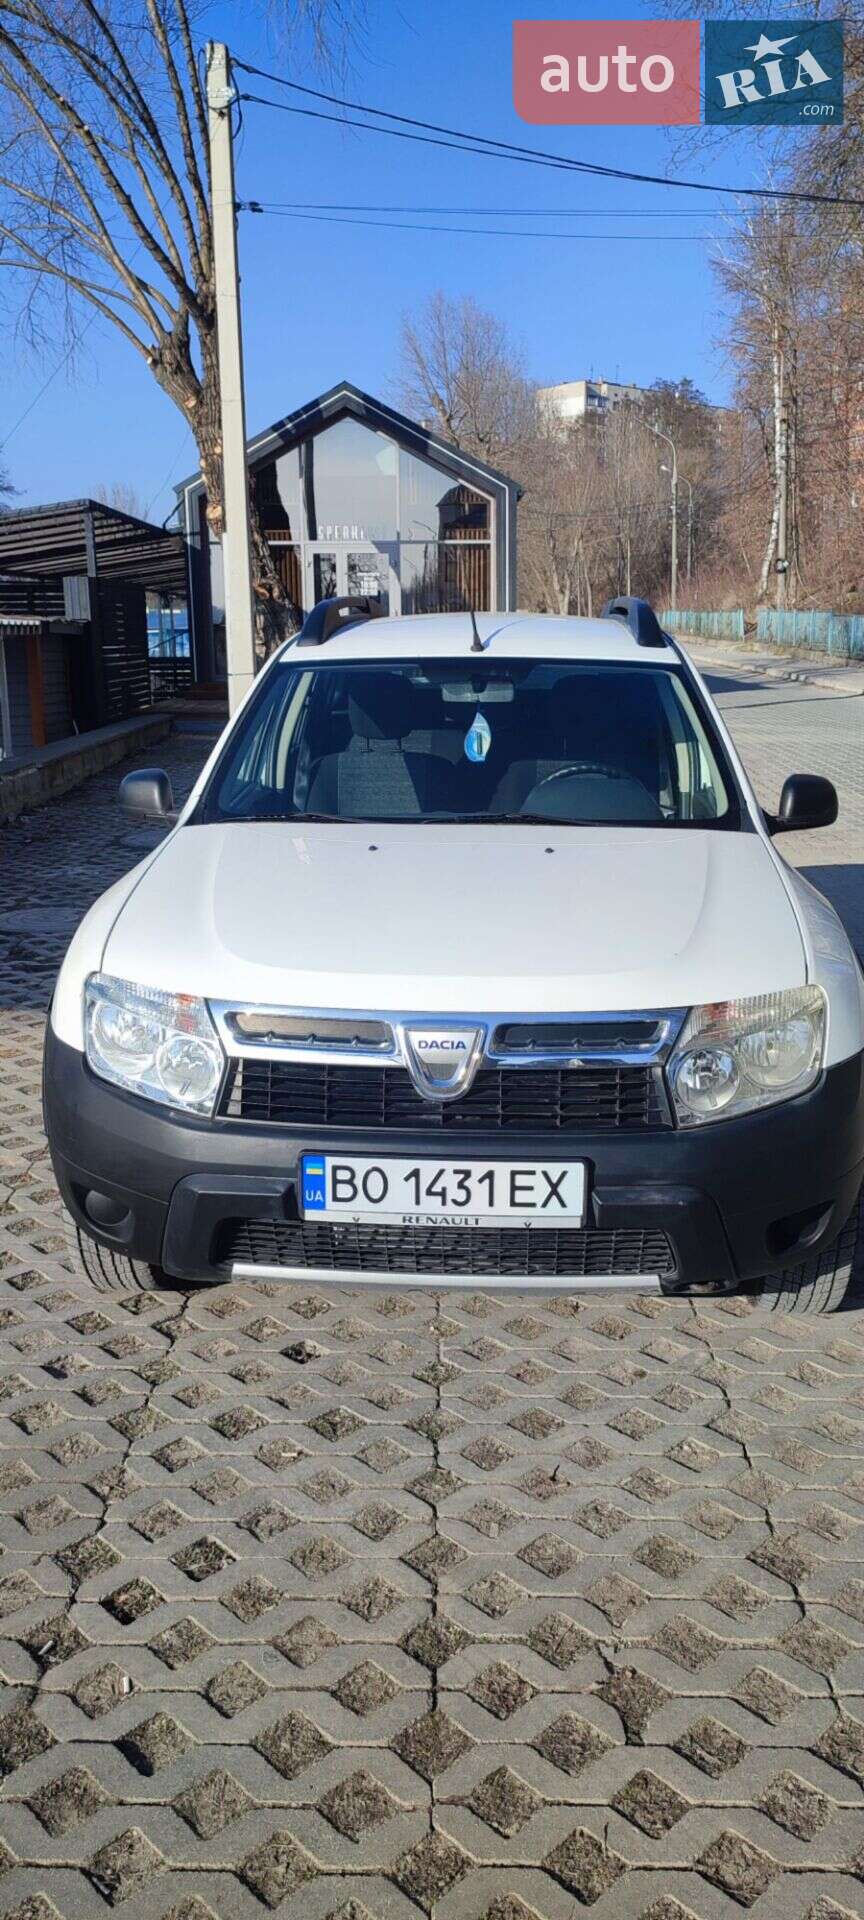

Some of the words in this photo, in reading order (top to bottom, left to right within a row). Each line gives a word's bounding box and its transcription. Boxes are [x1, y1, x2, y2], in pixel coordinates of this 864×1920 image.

[418, 1040, 466, 1050] DACIA
[332, 1165, 388, 1204] BO
[403, 1167, 495, 1208] 1431
[510, 1170, 568, 1208] EX
[306, 1190, 323, 1202] UA
[402, 1215, 480, 1226] RENAULT
